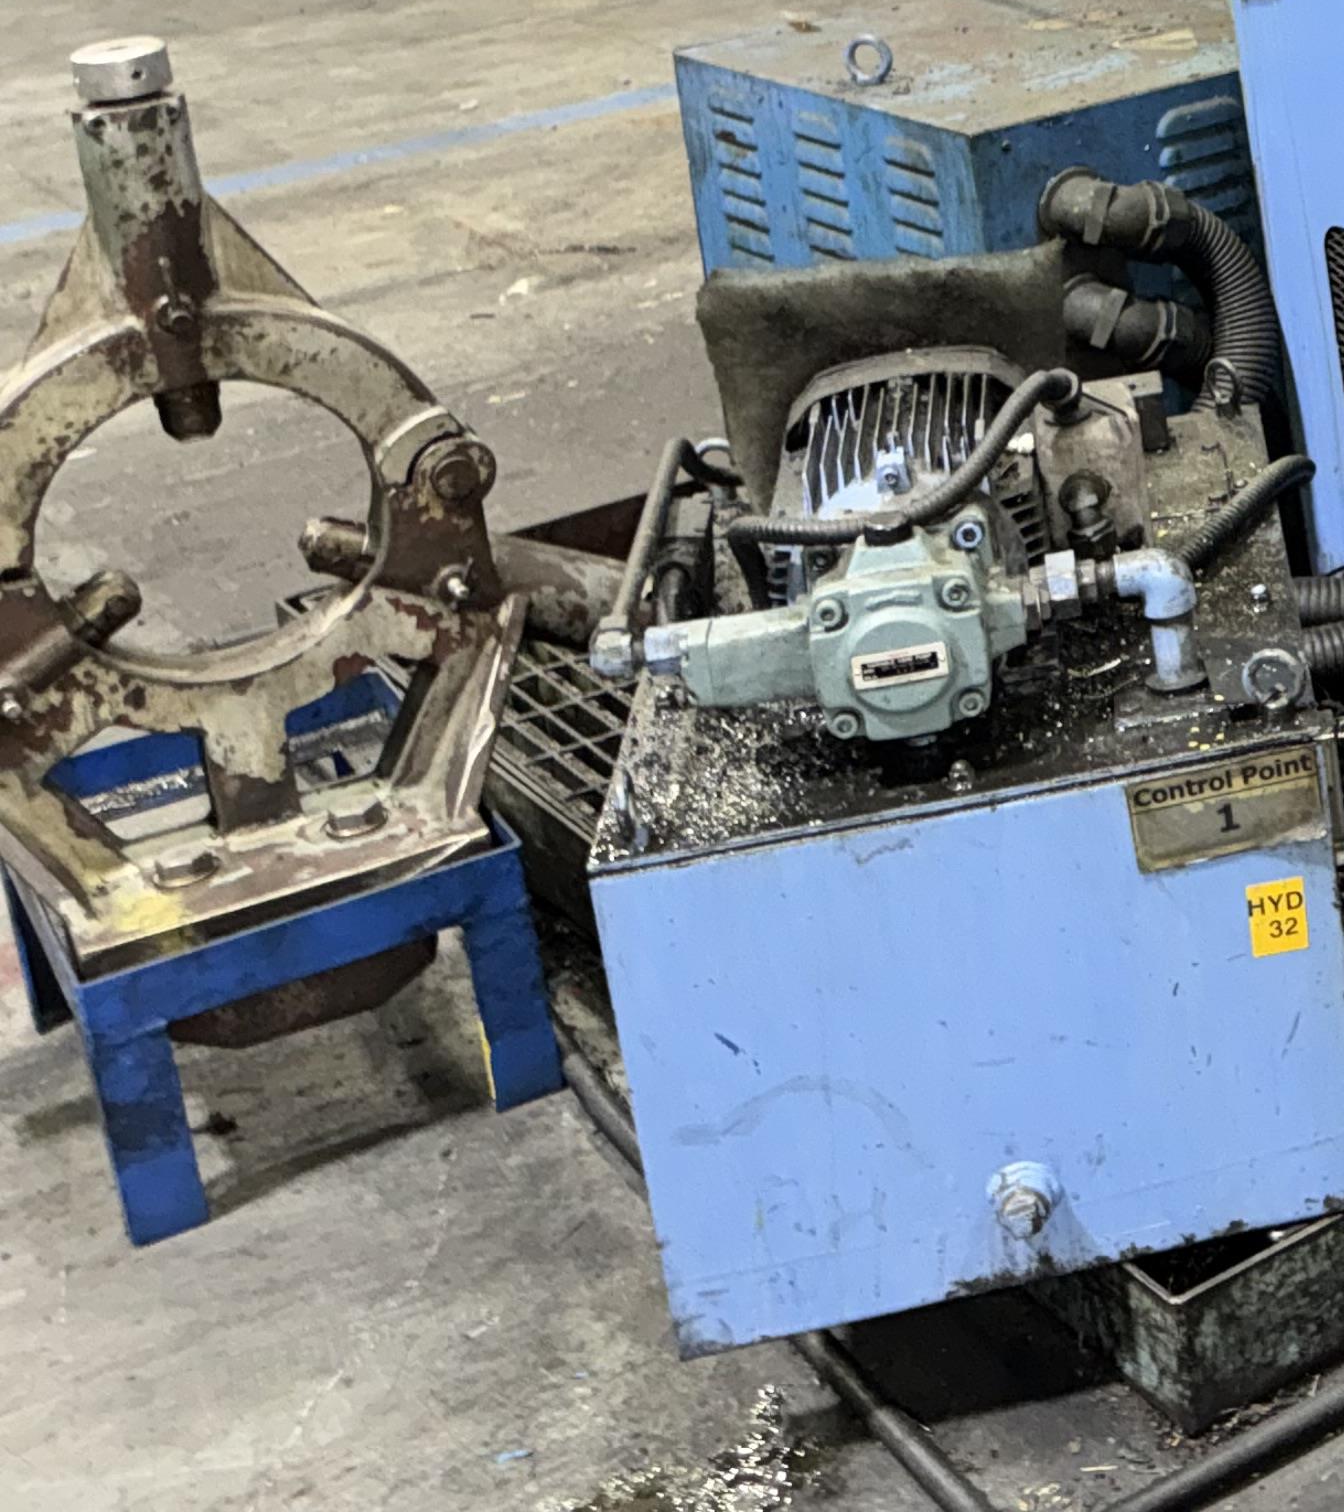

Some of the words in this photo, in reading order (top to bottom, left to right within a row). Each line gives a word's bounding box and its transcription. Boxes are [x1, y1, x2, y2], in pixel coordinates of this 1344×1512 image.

[1133, 770, 1233, 807] Control
[1241, 754, 1313, 785] Point
[1216, 803, 1240, 833] 1
[1247, 890, 1303, 918] HYD
[1269, 917, 1299, 939] 32
